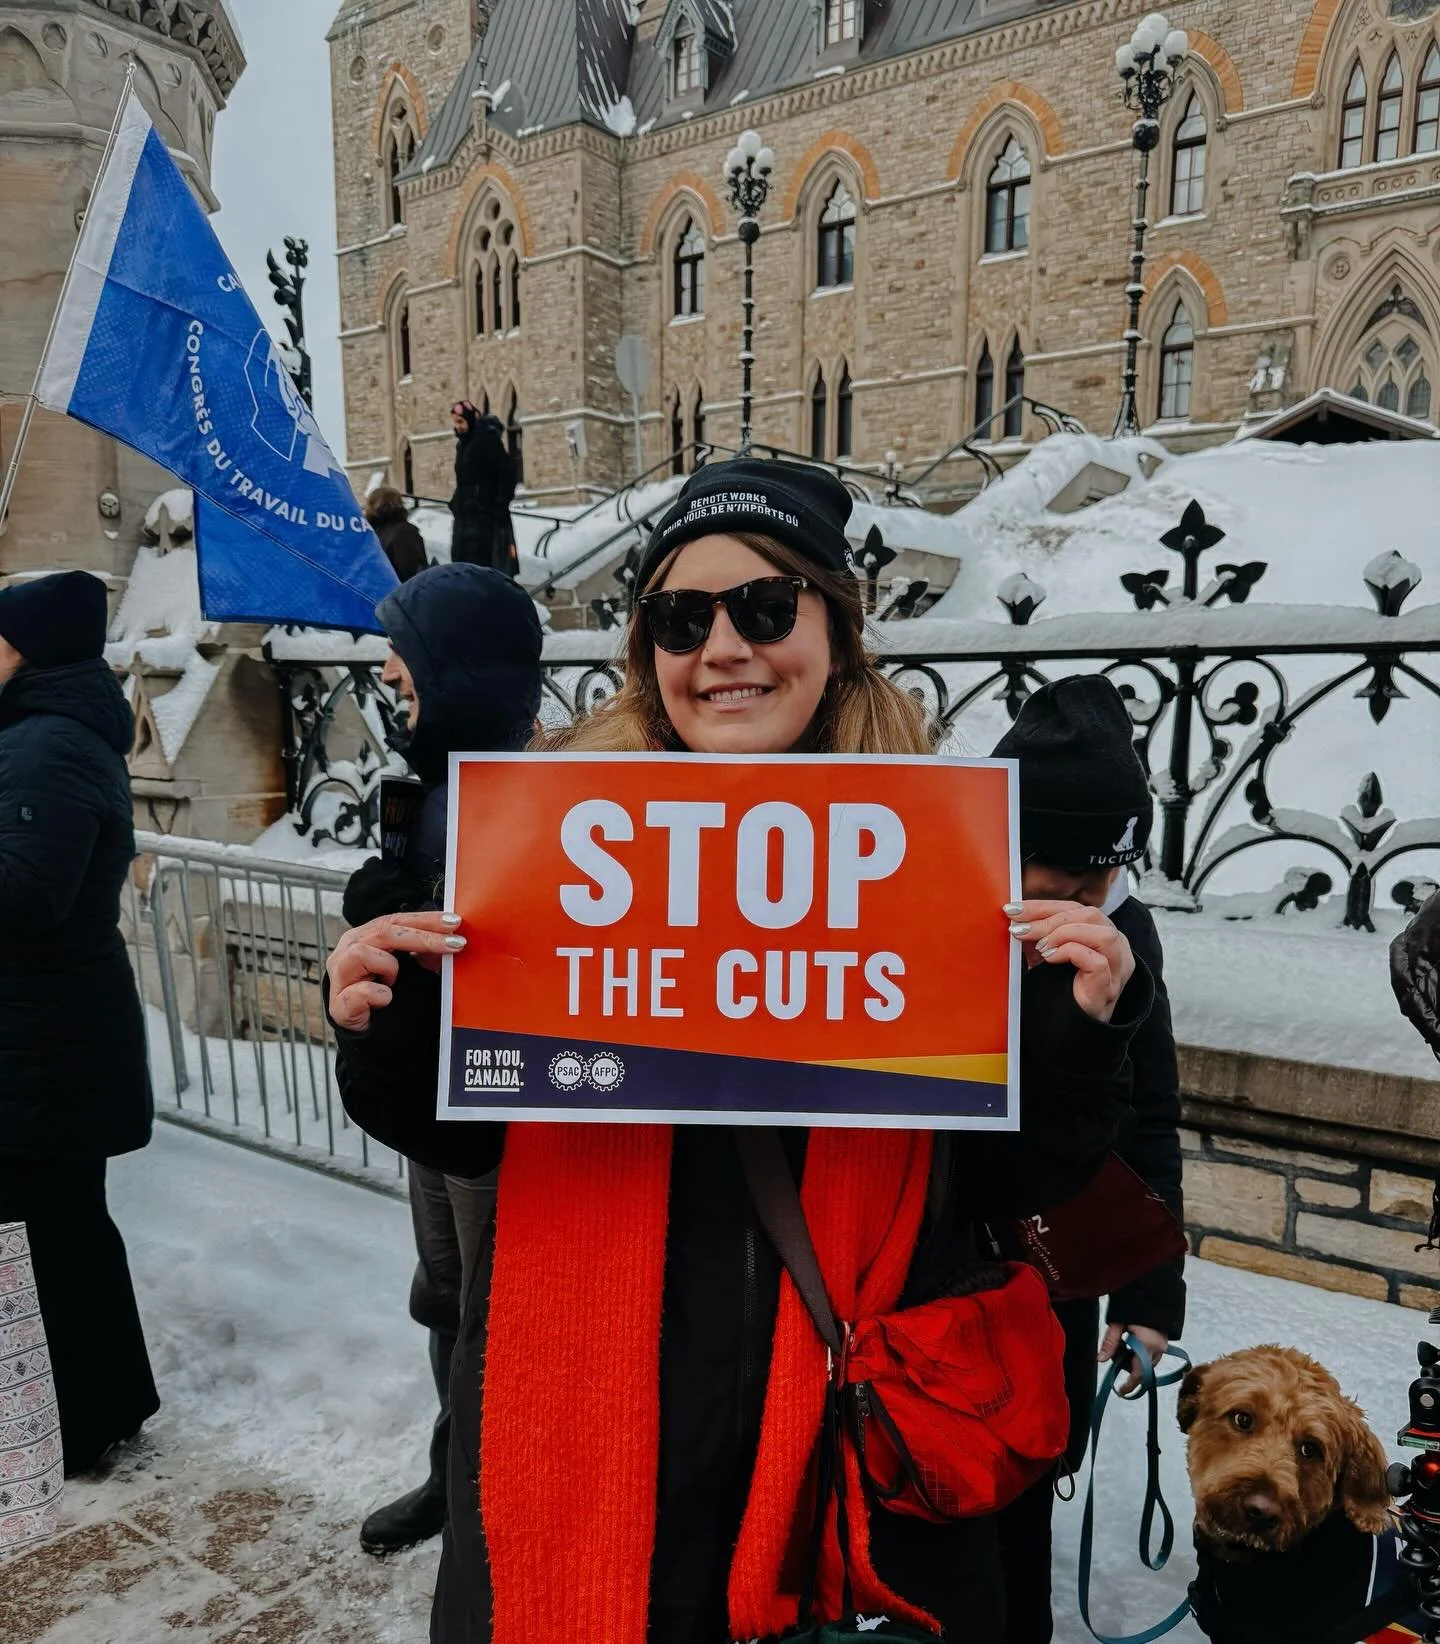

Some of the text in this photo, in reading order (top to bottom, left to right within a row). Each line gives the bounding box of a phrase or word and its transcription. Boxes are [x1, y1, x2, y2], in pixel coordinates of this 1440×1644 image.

[186, 319, 213, 436] CONGRÈS
[206, 438, 232, 471] DU
[229, 468, 309, 527] TRAVAIL
[316, 511, 345, 531] DU
[690, 491, 767, 509] REMOTE WORKS
[711, 504, 725, 516] DE
[726, 503, 784, 521] N'IMPORTE
[559, 799, 907, 929] STOP
[556, 947, 906, 1022] THE CUTS
[465, 1049, 525, 1069] FOR YOU,
[464, 1069, 525, 1086] CANADA.
[557, 1066, 580, 1077] PSAC
[594, 1067, 618, 1078] AFPC
